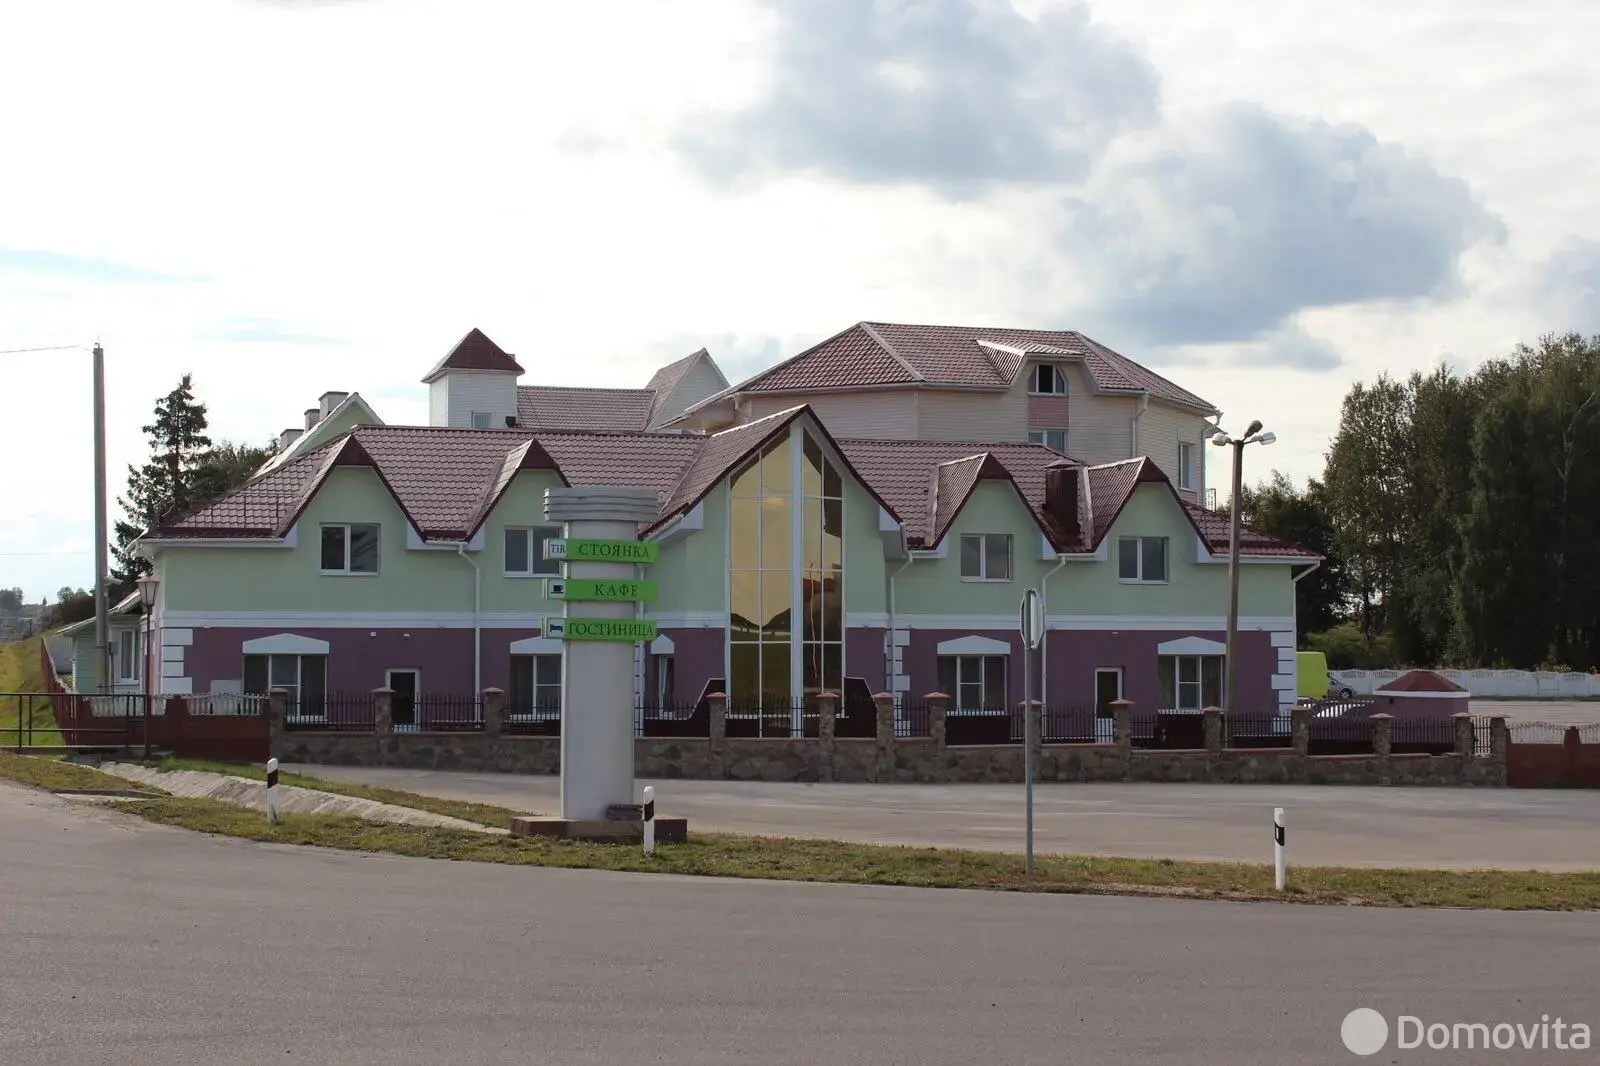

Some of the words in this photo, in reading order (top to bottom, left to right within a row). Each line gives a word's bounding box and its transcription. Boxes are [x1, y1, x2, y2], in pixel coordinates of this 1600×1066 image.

[550, 543, 566, 554] TIR
[579, 544, 650, 557] СТОЯНКА
[594, 584, 640, 597] КАФЕ
[568, 622, 654, 637] ГОСТИНИЦА
